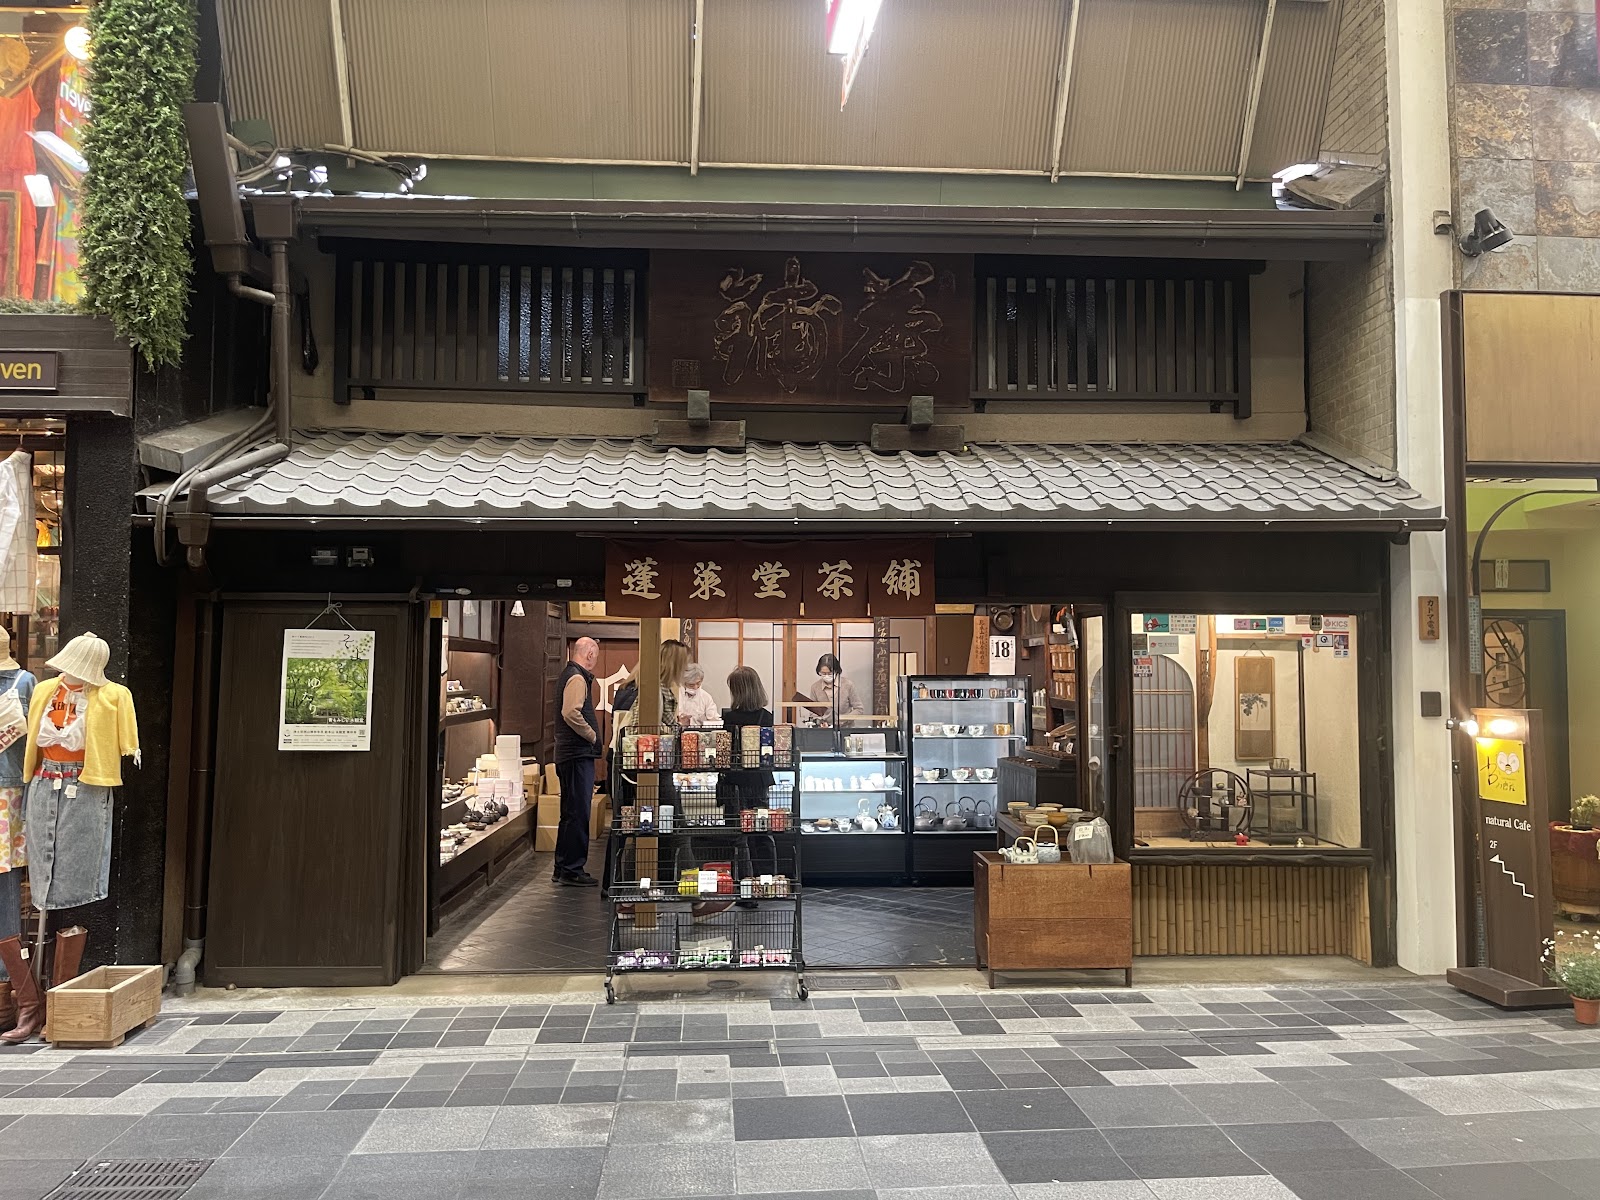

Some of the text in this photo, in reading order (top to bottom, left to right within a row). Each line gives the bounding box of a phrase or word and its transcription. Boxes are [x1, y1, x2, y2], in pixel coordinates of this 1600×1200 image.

[1331, 620, 1348, 628] KICS
[994, 641, 1010, 658] 18
[1485, 815, 1532, 832] natural Cafe
[1489, 840, 1498, 849] 2F
